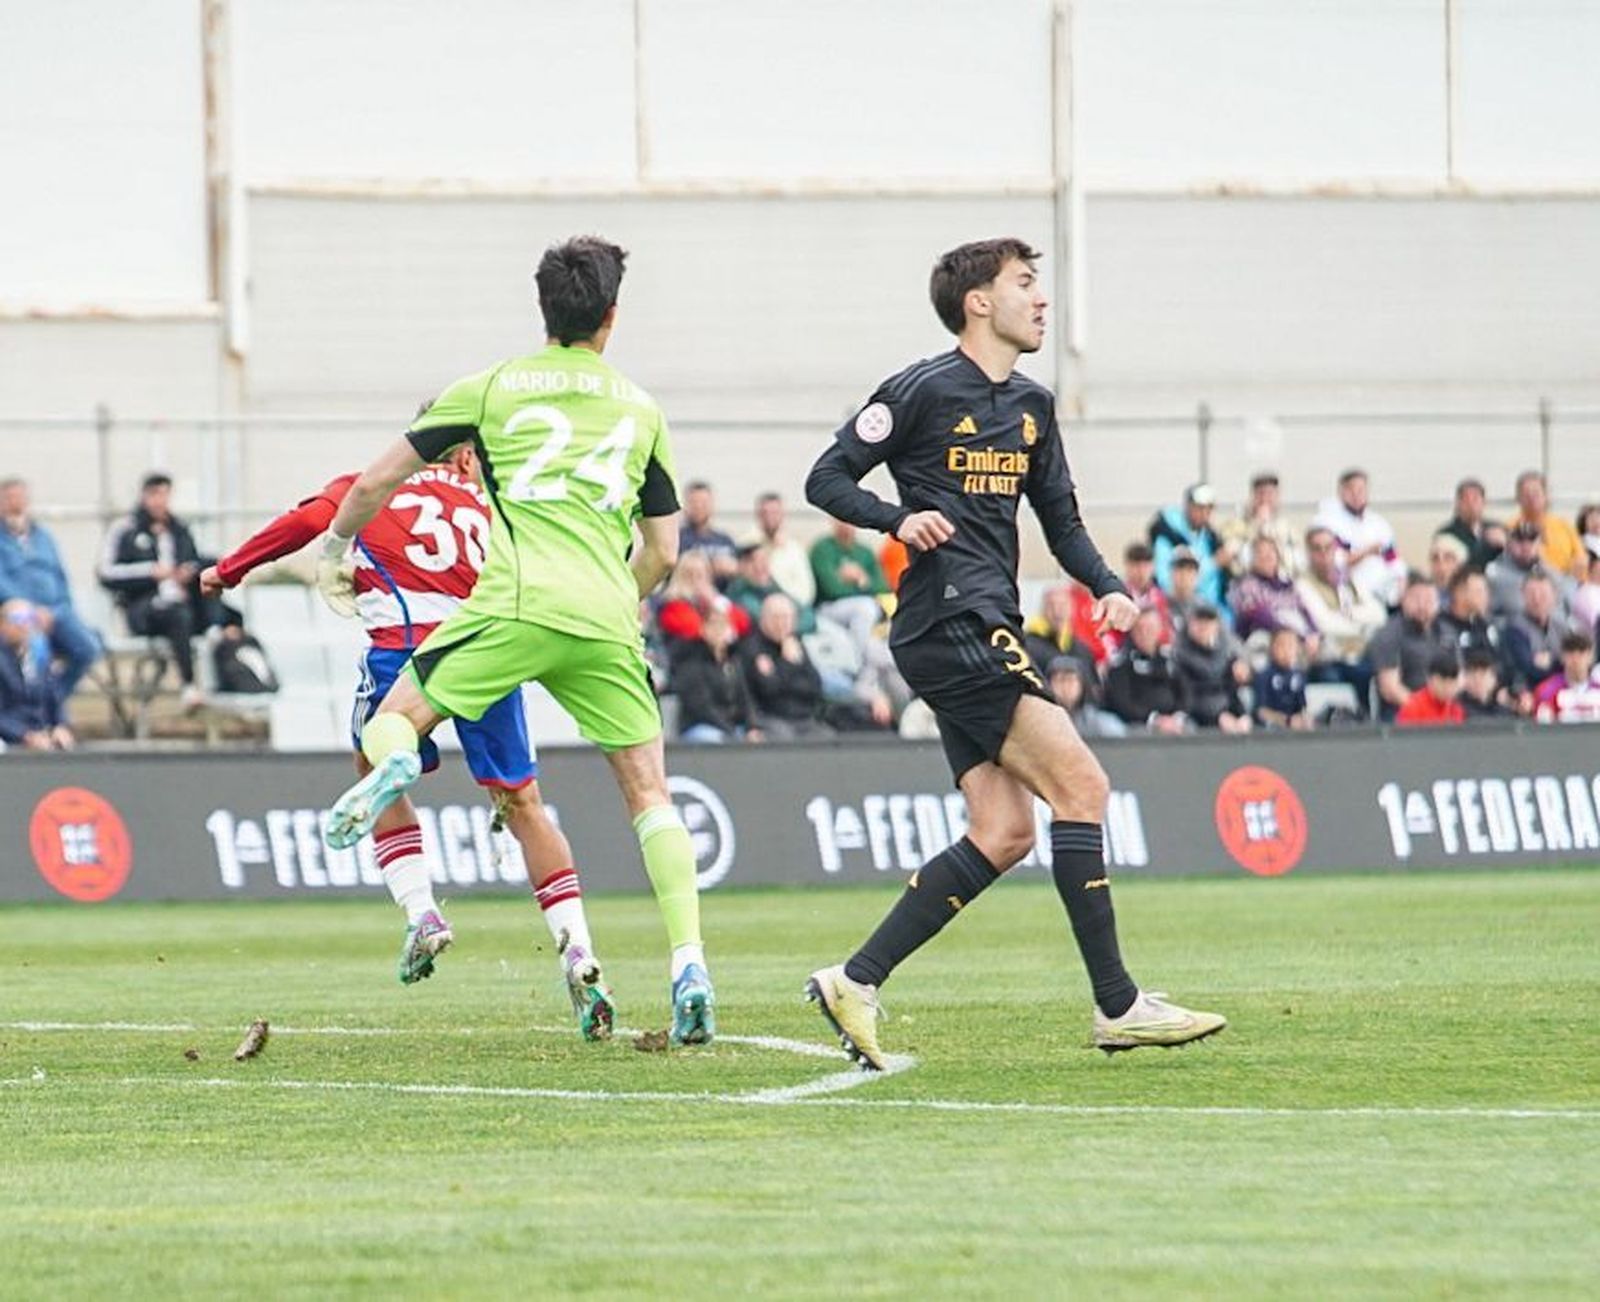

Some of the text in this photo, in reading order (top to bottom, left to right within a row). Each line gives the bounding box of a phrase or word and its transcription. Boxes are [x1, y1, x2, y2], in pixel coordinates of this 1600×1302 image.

[500, 370, 568, 392] MARIO
[577, 372, 605, 396] DE
[503, 404, 636, 512] 24
[389, 492, 490, 573] 30
